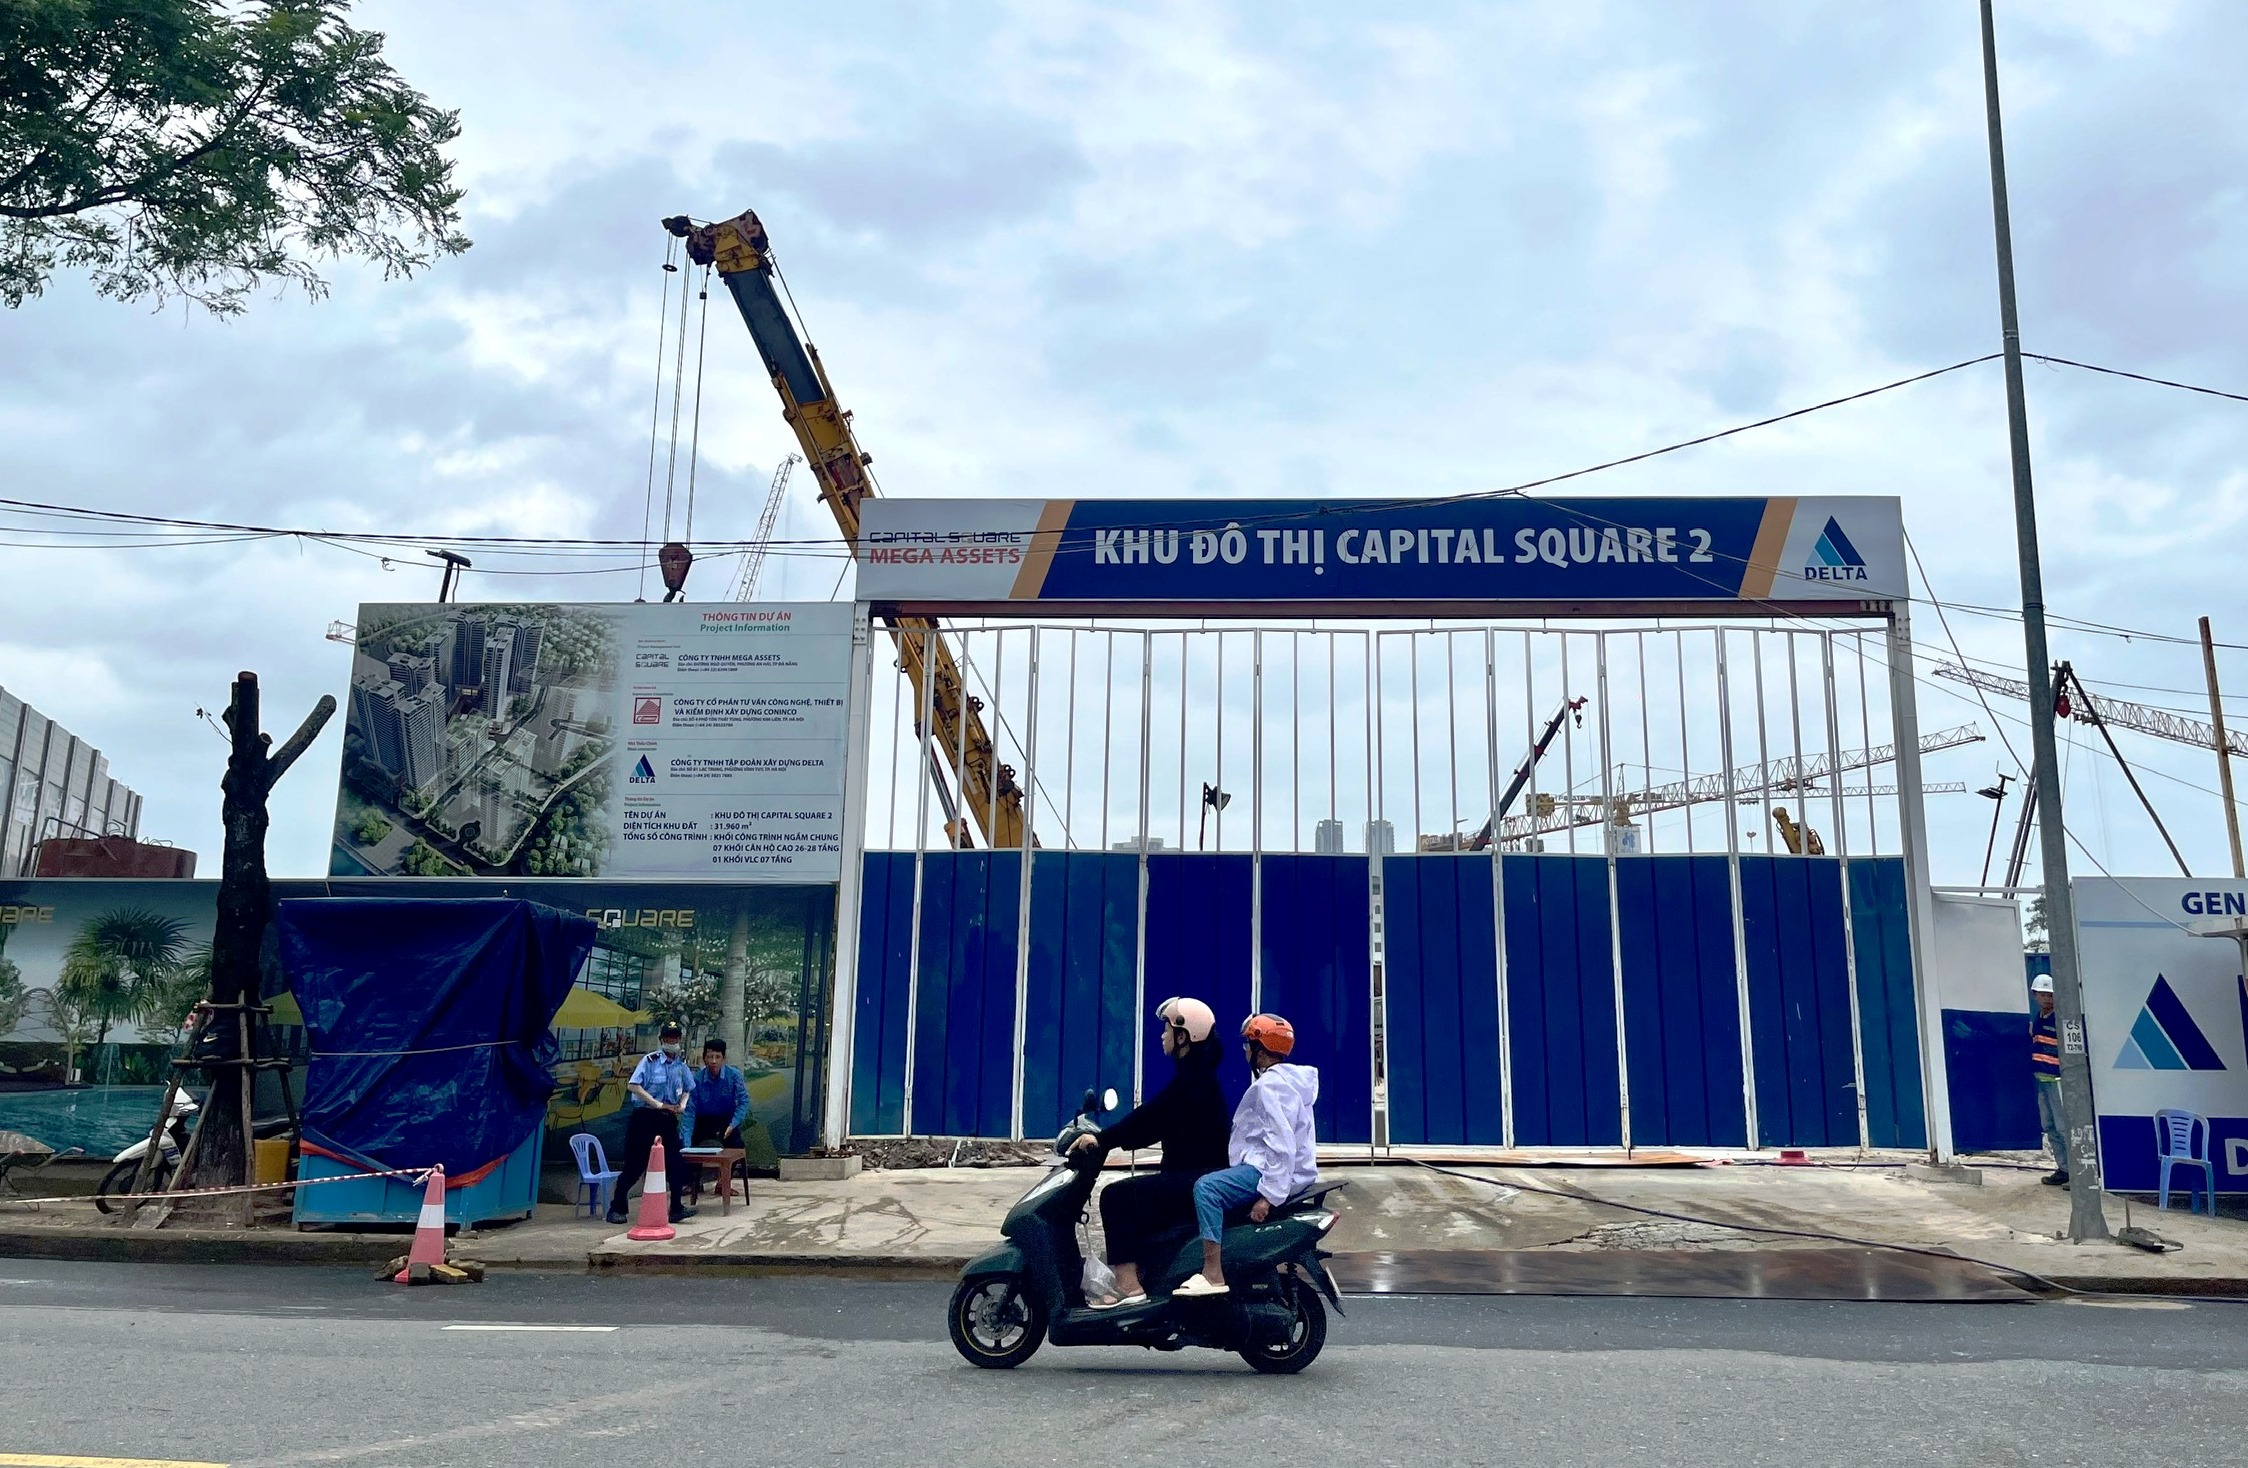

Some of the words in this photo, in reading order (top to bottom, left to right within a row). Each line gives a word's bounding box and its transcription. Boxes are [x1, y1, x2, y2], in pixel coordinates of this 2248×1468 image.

[1095, 530, 1178, 564] KHU
[1190, 522, 1247, 564] ĐÔ
[1257, 530, 1324, 576] THỊ
[1336, 528, 1504, 564] CAPITAL
[1514, 528, 1678, 568] SQUARE
[1689, 528, 1713, 562] 2
[870, 548, 934, 564] MEGA
[940, 548, 1020, 564] ASSETS
[1804, 566, 1868, 580] DELTA
[702, 612, 738, 621] THÔNG
[758, 612, 775, 623] DỰ
[776, 611, 791, 620] ÁN
[700, 624, 732, 634] Project
[734, 624, 790, 632] Information
[740, 708, 762, 716] DỰNG
[740, 758, 761, 766] ĐOÀN
[779, 759, 800, 768] DỰNG
[640, 811, 653, 820] DỰ
[734, 811, 745, 819] ĐÔ
[747, 812, 759, 820] THỊ
[794, 812, 826, 820] SQUARE
[624, 822, 642, 831] DIỆN
[644, 822, 662, 830] TÍCH
[682, 821, 698, 830] ĐẤT
[647, 832, 658, 840] SỐ
[714, 832, 733, 840] KHỐI
[735, 832, 757, 840] CÔNG
[763, 844, 775, 853] HỘ
[724, 855, 743, 863] KHỐI
[2181, 892, 2246, 914] GEN
[0, 906, 55, 924] ARE
[2066, 1020, 2080, 1030] CS
[2067, 1032, 2082, 1042] 106
